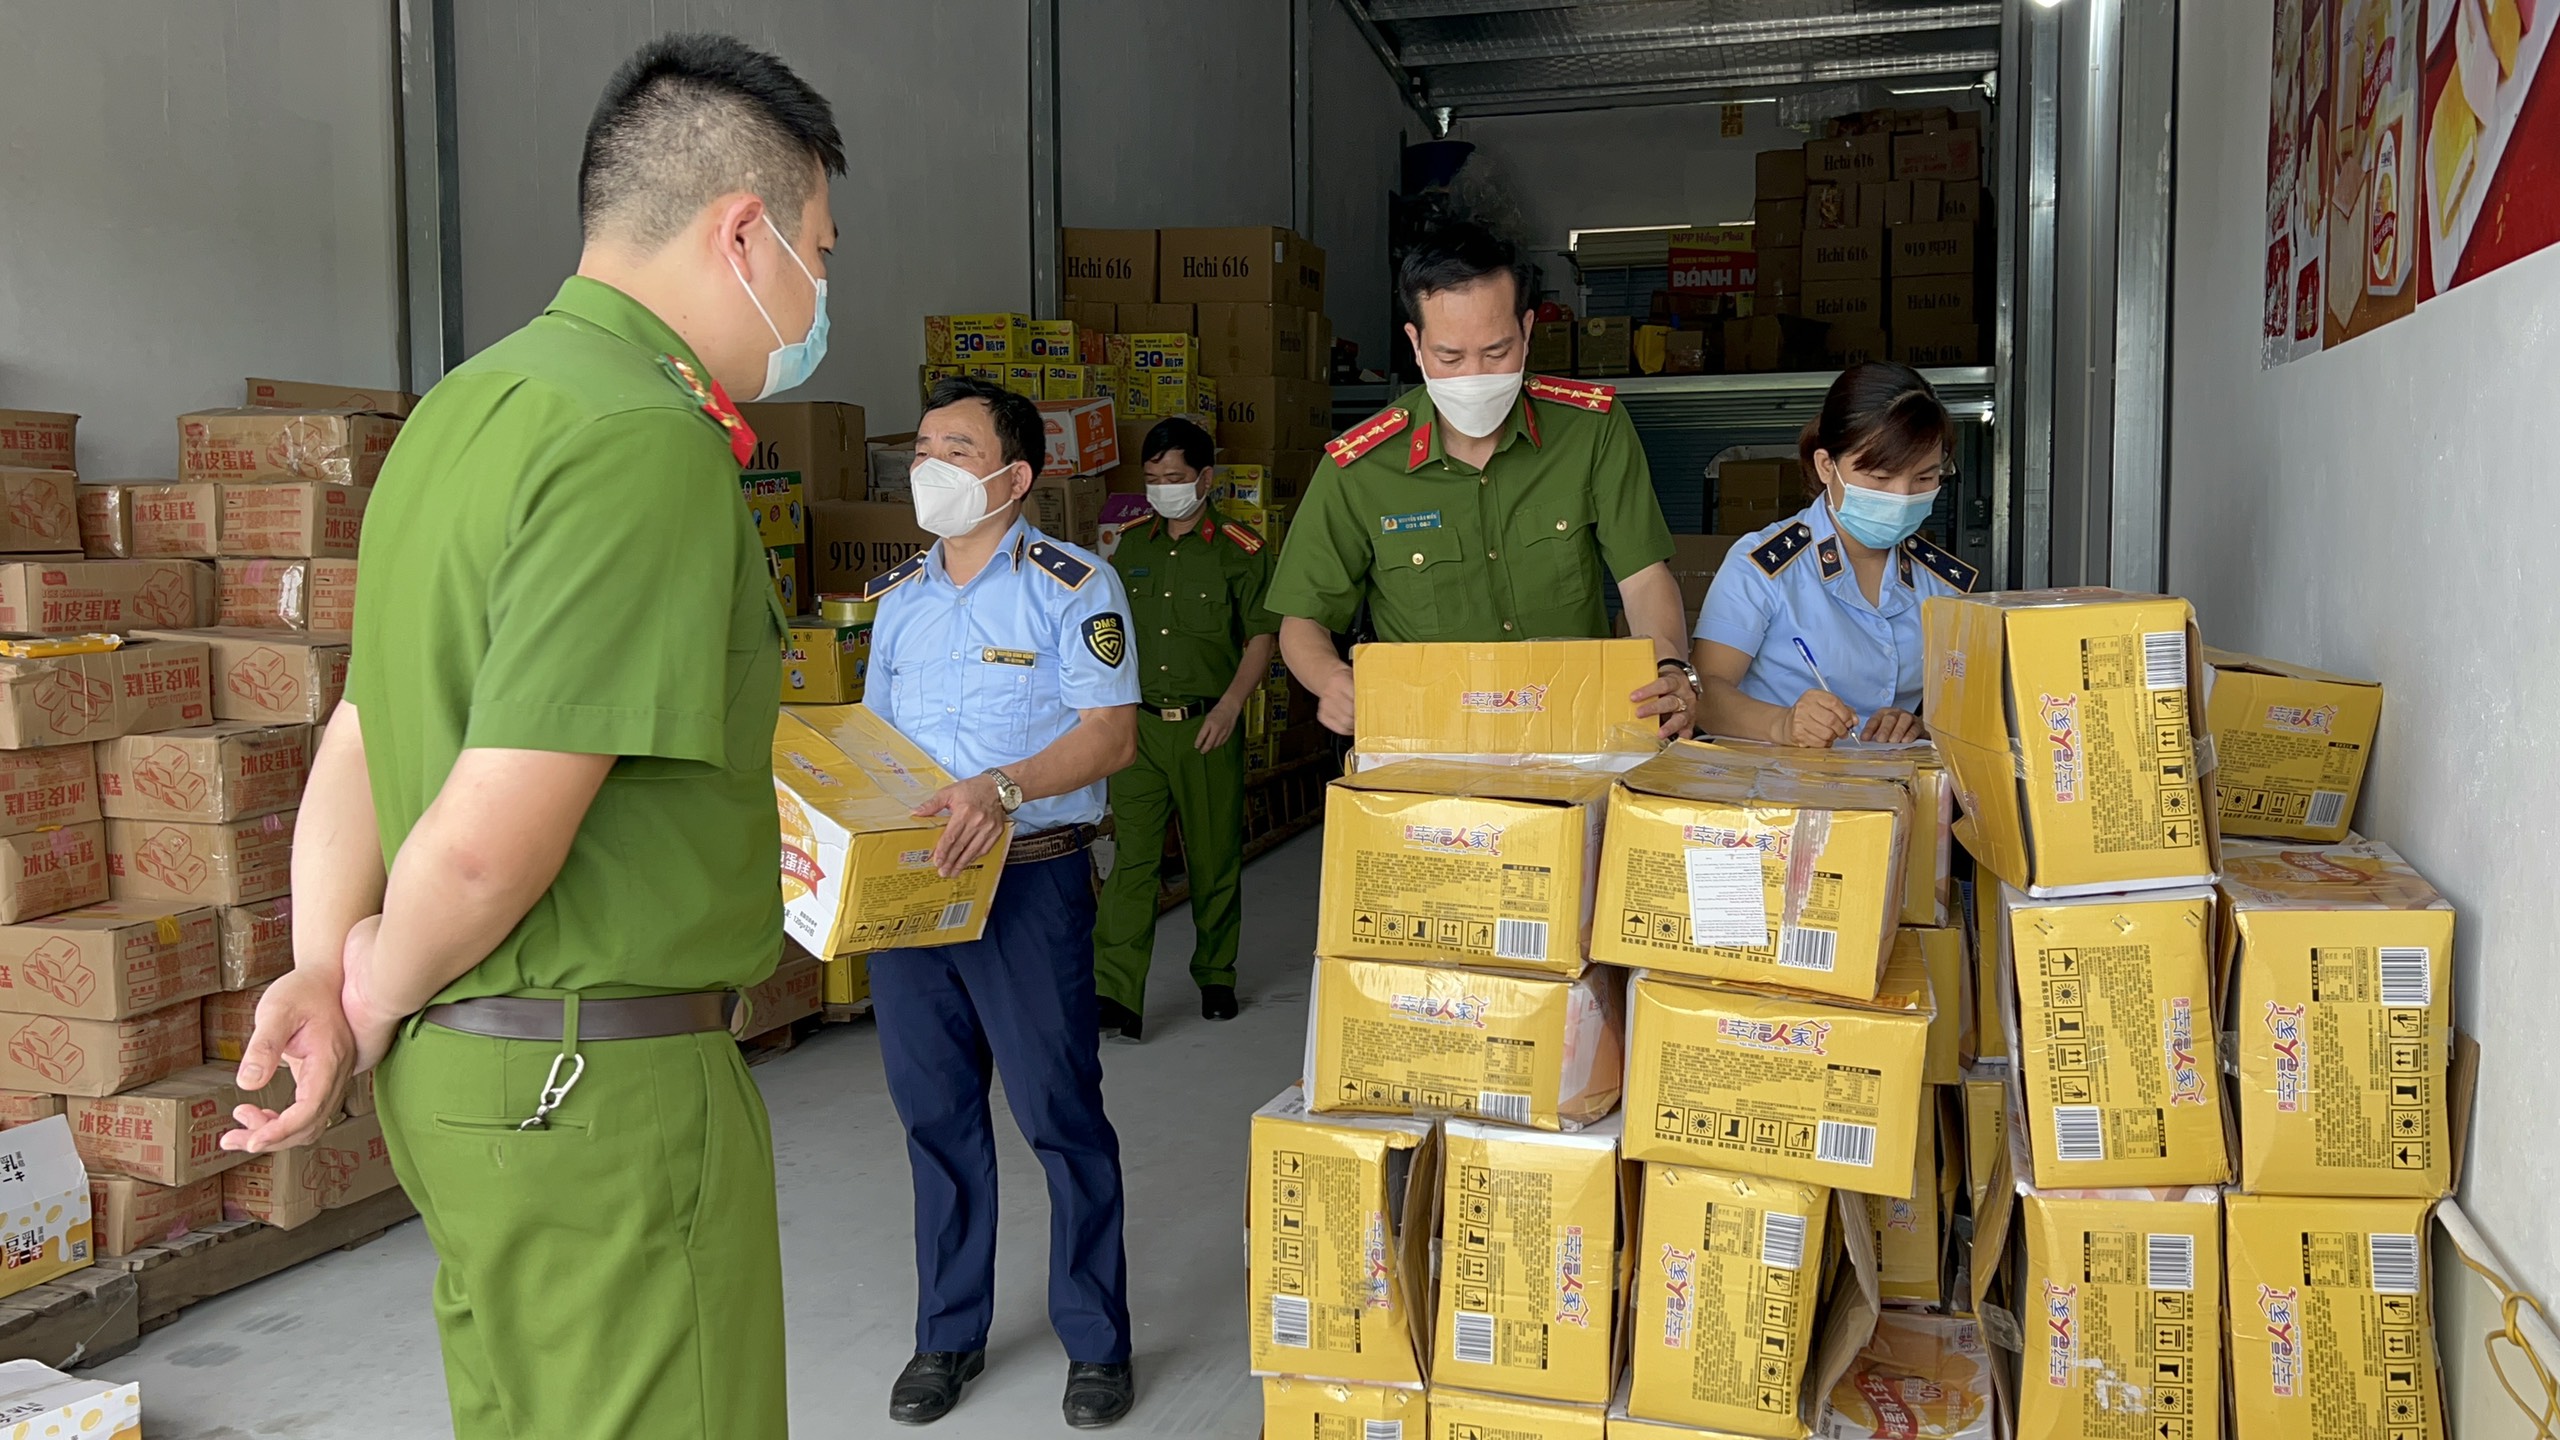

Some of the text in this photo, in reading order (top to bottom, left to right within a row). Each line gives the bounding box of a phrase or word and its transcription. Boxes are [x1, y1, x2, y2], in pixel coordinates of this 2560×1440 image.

[1068, 257, 1132, 279] Hchi 616
[1183, 255, 1249, 278] Hchi 616
[1673, 266, 1733, 287] BÁNH
[955, 333, 984, 351] 3Q
[1031, 338, 1047, 356] Q
[1135, 351, 1163, 367] 3Q
[1050, 368, 1066, 378] 3Q
[1228, 401, 1255, 423] 616
[187, 450, 257, 471] 冰皮蛋糕
[135, 501, 196, 522] 冰皮蛋糕
[325, 518, 358, 539] 冰皮
[829, 541, 864, 572] 616
[42, 599, 121, 624] 冰皮蛋糕
[1093, 618, 1117, 631] DMS
[123, 665, 201, 697] 冰皮蛋糕
[1470, 690, 1533, 708] 幸福人家
[240, 746, 303, 777] 冰皮蛋糕
[2046, 709, 2076, 793] 幸福人家
[5, 781, 86, 816] 冰皮蛋糕
[1414, 825, 1490, 849] 幸福人家
[252, 922, 286, 944] 冰皮
[1399, 995, 1475, 1021] 幸福人家
[1727, 1019, 1814, 1047] 幸福人家
[2171, 1007, 2197, 1092] 幸福人家
[2273, 1017, 2300, 1102] 幸福人家
[79, 1110, 153, 1141] 冰皮蛋糕
[6, 1246, 43, 1270] ケーキ
[1561, 1236, 1587, 1313] 幸福人家
[1662, 1261, 1689, 1337] 幸福人家
